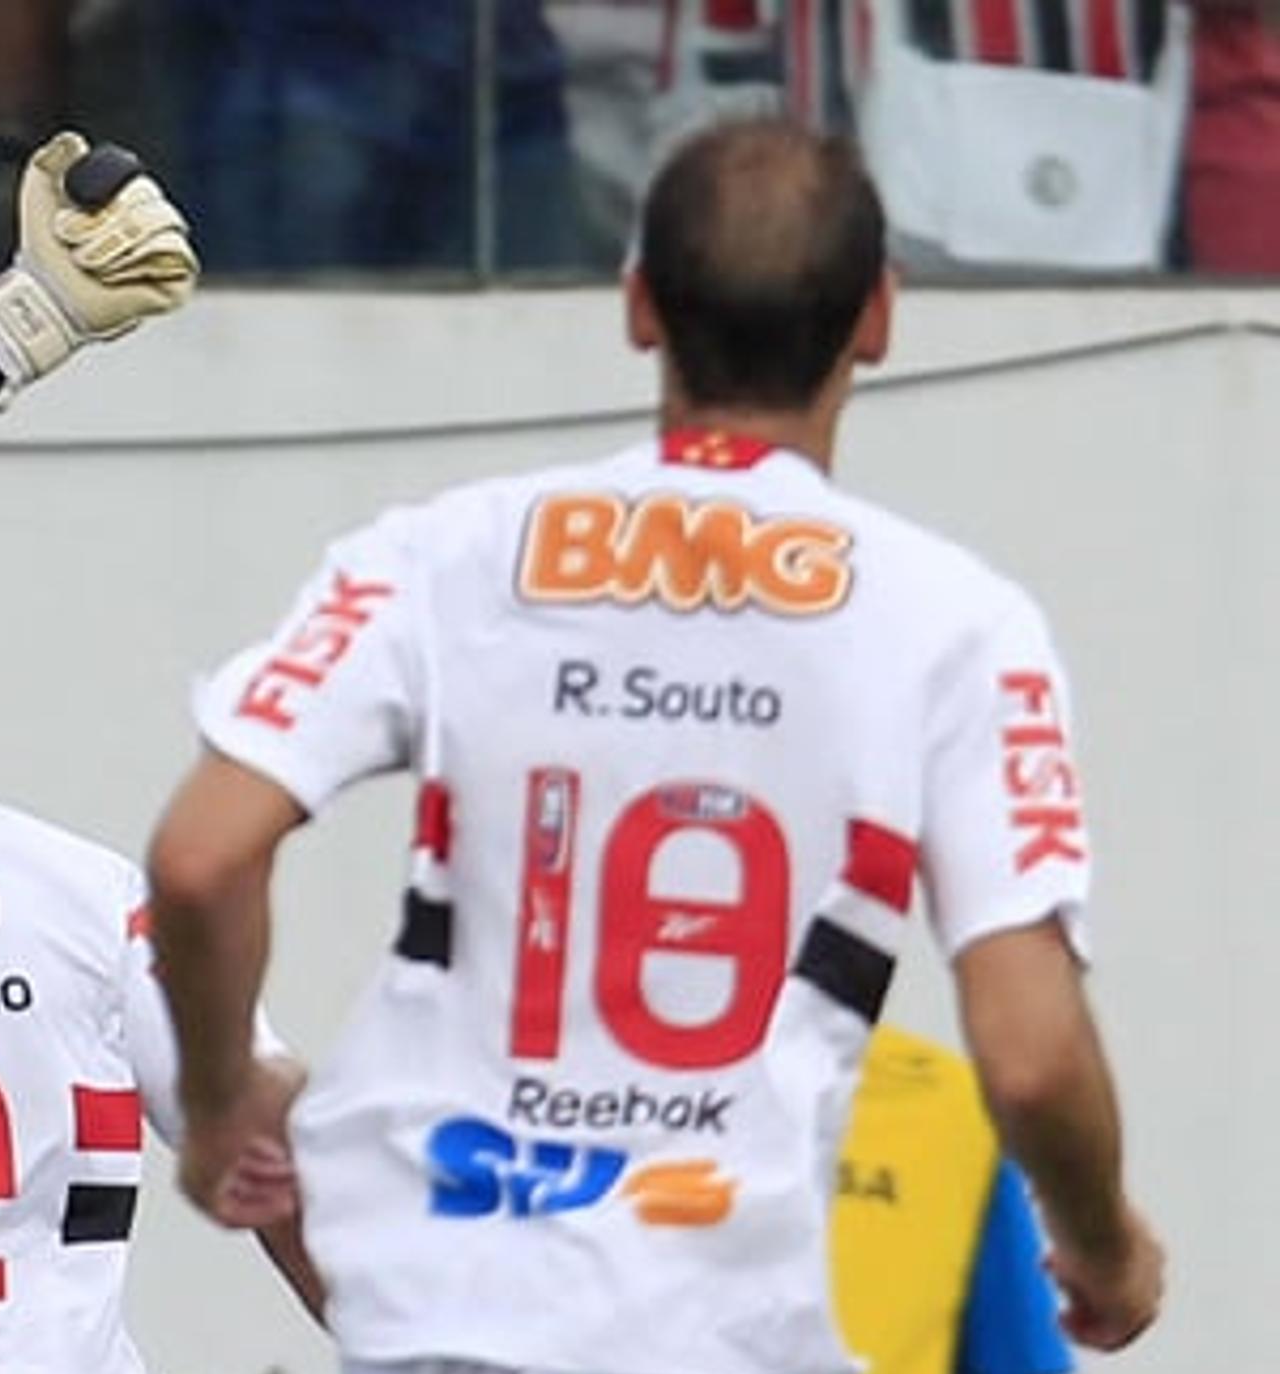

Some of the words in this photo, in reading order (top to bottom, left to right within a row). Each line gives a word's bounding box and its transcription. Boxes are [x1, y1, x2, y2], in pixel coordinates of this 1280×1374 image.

[516, 490, 855, 620] BMG
[233, 568, 395, 731] FISK
[998, 672, 1085, 876] FISK
[508, 766, 792, 1072] 18
[507, 1077, 736, 1133] Reebok
